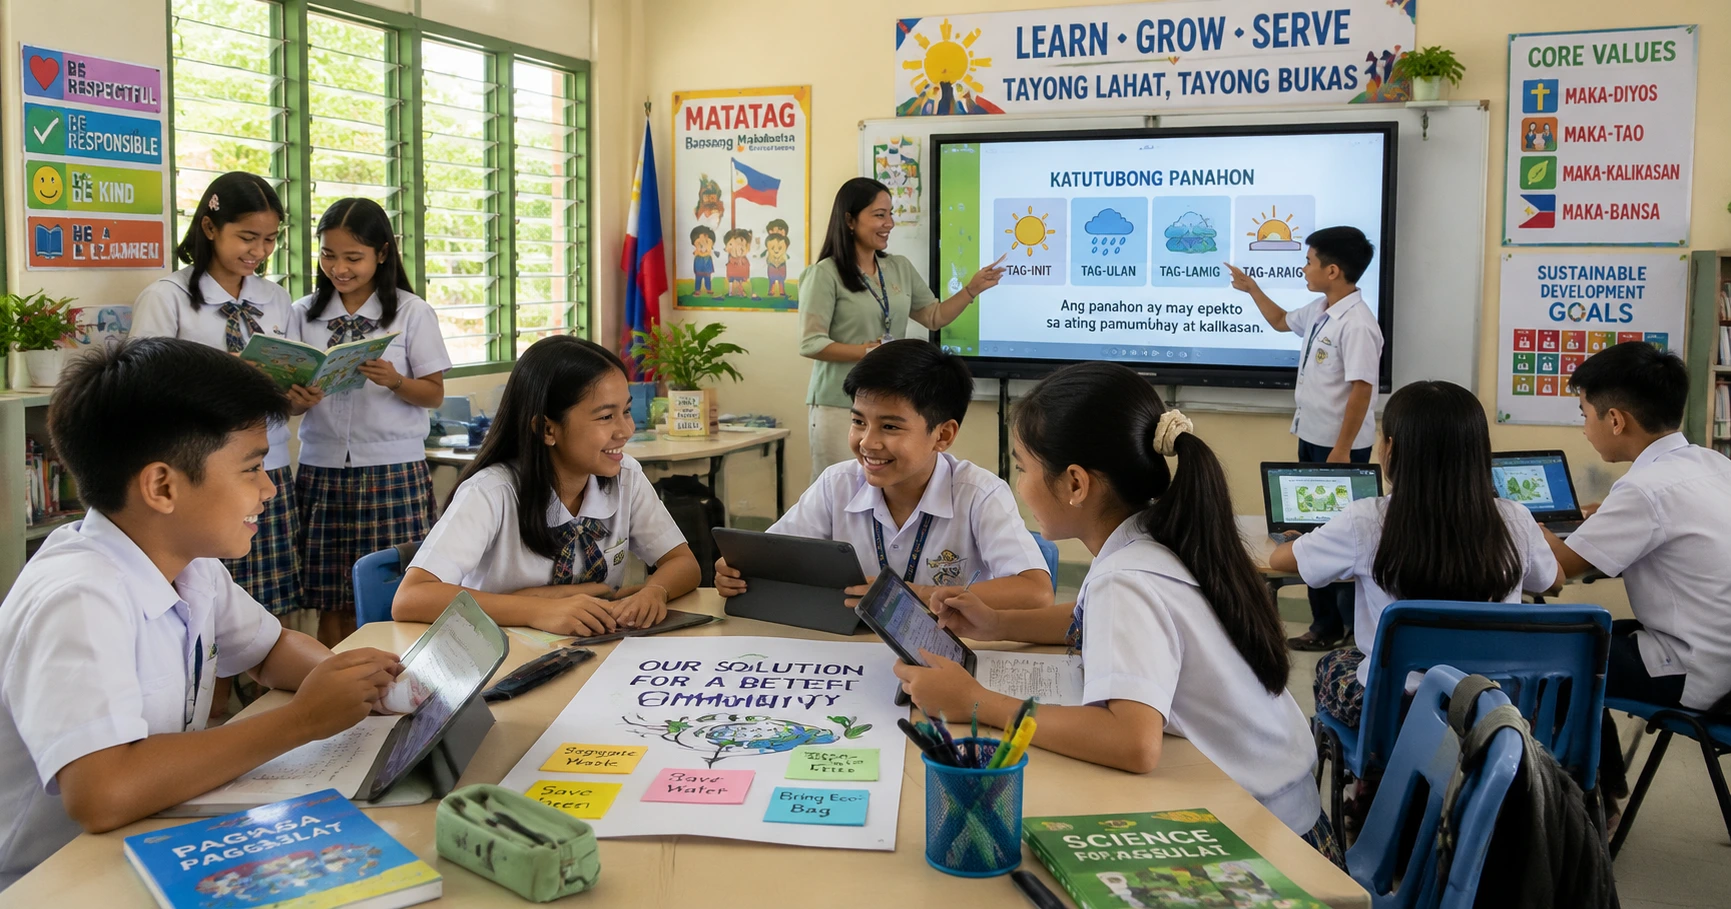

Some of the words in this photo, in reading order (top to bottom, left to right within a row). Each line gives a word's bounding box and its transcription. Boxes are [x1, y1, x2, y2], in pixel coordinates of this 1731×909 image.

[1015, 21, 1109, 60] LEARN
[1135, 15, 1227, 54] GROW
[1251, 8, 1352, 49] SERVE
[1527, 45, 1585, 68] CORE
[1592, 40, 1677, 65] VALUES
[1002, 74, 1089, 102] TAYONG
[1095, 71, 1171, 101] LAHAT,
[1179, 67, 1271, 97] TAYONG
[1278, 63, 1359, 94] BUKAS
[1564, 83, 1659, 105] MAKA-DIYOS
[685, 102, 796, 132] MATATAG
[1563, 124, 1645, 143] MAKA-TAO
[68, 132, 159, 156] RESPONSIBLE
[1050, 170, 1163, 188] KATUTUBONG
[1169, 168, 1255, 187] PANAHON
[1562, 163, 1681, 182] MAKA-KALIKASAN
[98, 181, 135, 205] KIND
[1562, 202, 1661, 221] MAKA-BANSA
[1005, 264, 1052, 277] TAG-INIT
[1081, 264, 1137, 278] TAG-ULAN
[1159, 265, 1221, 279] TAG-LAMIG
[1537, 265, 1647, 281] SUSTAINABLE
[1540, 284, 1646, 300] DEVELOPMENT
[1060, 300, 1085, 314] Ang
[1088, 300, 1143, 315] panahon
[1147, 304, 1162, 316] ay
[1165, 304, 1194, 317] may
[1197, 302, 1243, 317] epekto
[1548, 301, 1634, 324] GOALS
[1046, 318, 1061, 329] sa
[1064, 318, 1097, 333] ating
[1182, 320, 1196, 332] at
[638, 660, 702, 673] OUR
[629, 675, 691, 688] FOR
[704, 676, 726, 688] A
[779, 791, 825, 805] Bring
[789, 803, 832, 818] Bag
[1062, 829, 1219, 850] SCIENCE
